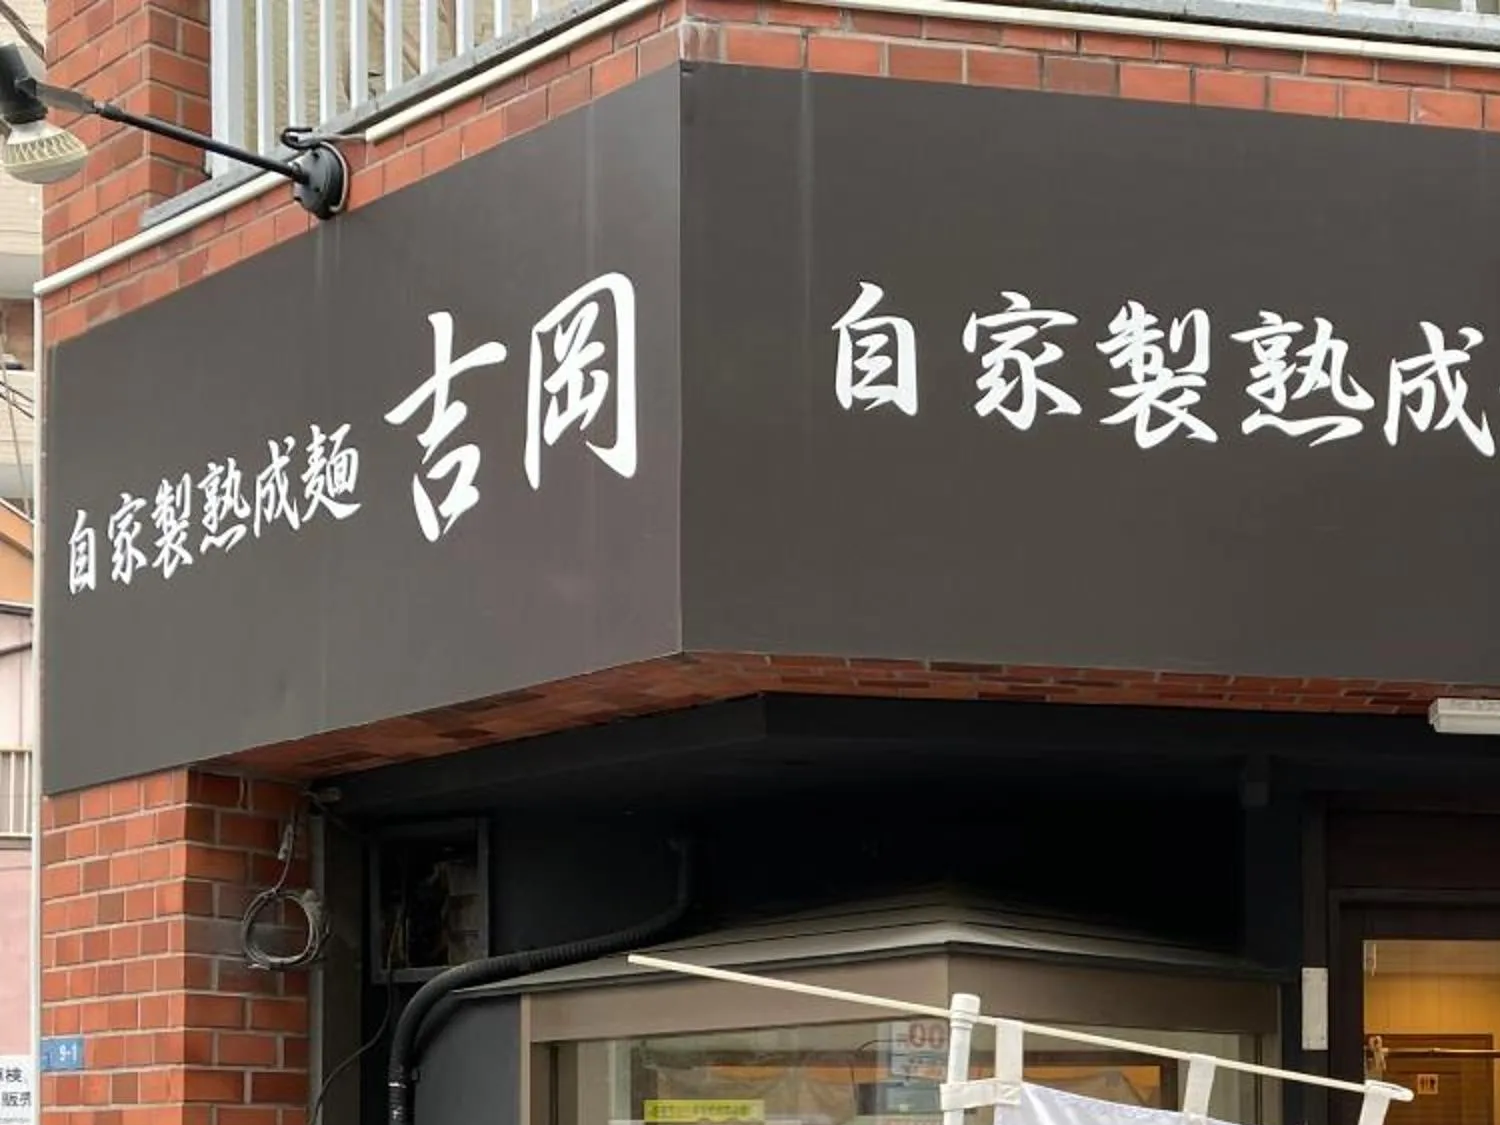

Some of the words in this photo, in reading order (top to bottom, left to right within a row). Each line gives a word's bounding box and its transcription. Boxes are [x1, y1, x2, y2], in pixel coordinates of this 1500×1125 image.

[68, 423, 361, 594] 自家製熟成麺
[384, 272, 637, 542] 吉岡
